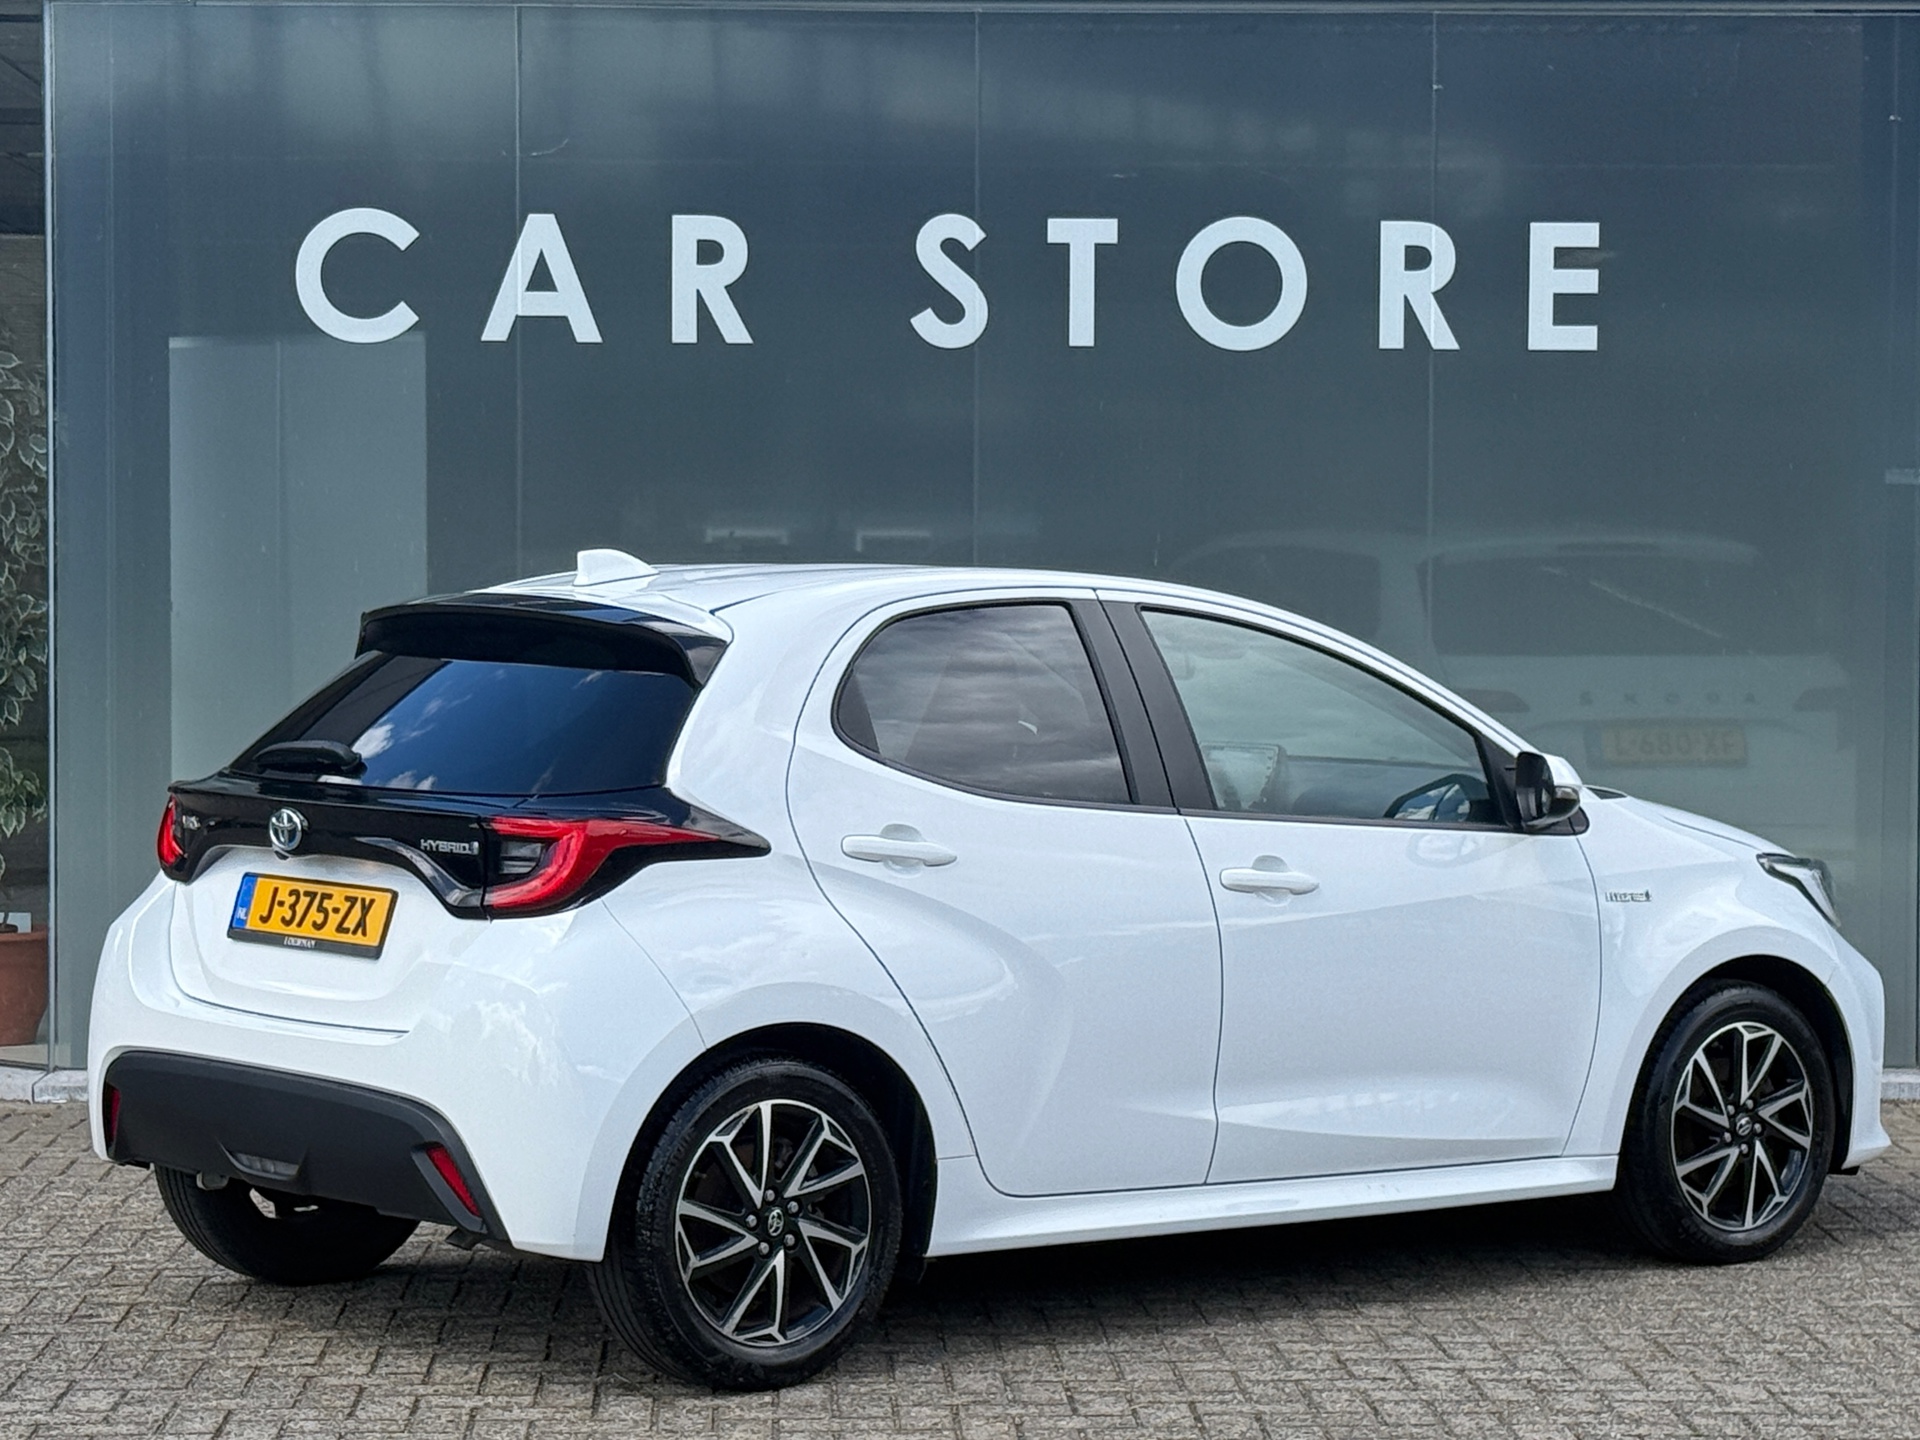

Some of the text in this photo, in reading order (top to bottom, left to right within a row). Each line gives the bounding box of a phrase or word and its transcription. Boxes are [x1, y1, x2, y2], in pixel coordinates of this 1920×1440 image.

[295, 207, 1601, 352] CAR STORE
[420, 838, 470, 854] HYBRID
[258, 886, 376, 938] J-375-ZX
